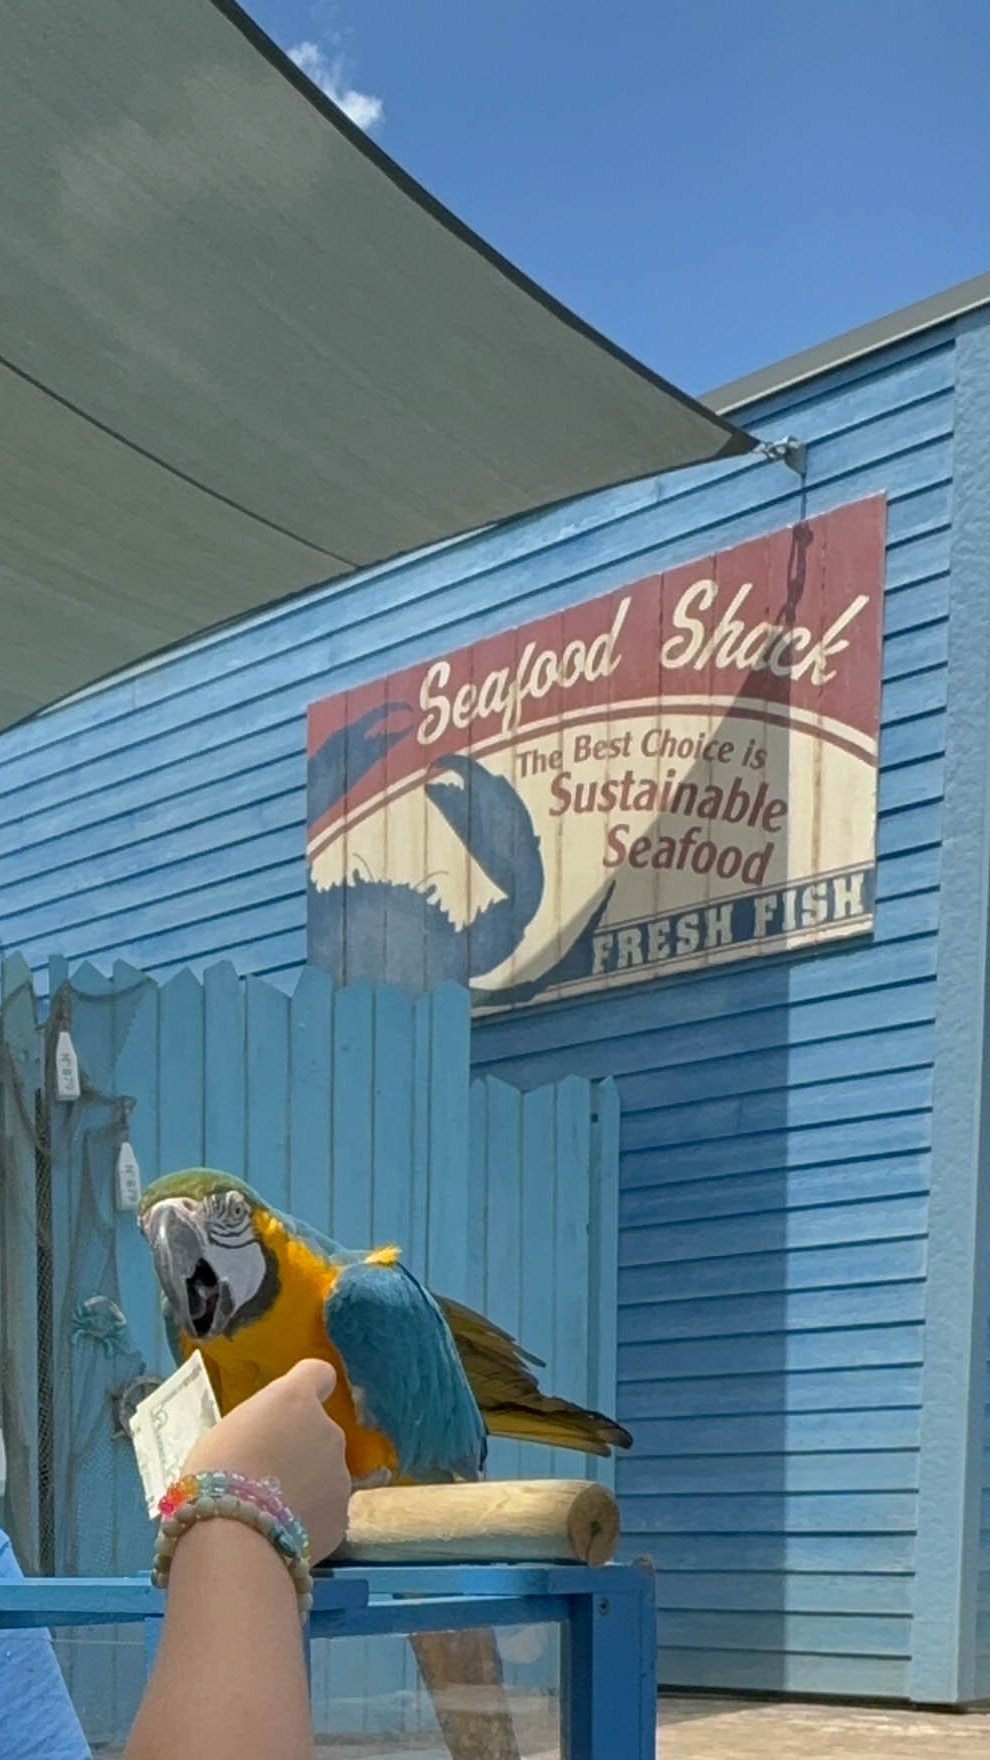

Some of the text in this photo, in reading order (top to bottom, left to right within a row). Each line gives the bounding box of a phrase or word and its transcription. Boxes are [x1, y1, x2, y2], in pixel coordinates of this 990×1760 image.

[417, 579, 869, 745] Seafood Shack
[516, 729, 767, 778] The Best Choice is
[549, 768, 789, 833] Sustainable
[603, 823, 775, 886] Seafood
[592, 872, 865, 977] FRESH FISH
